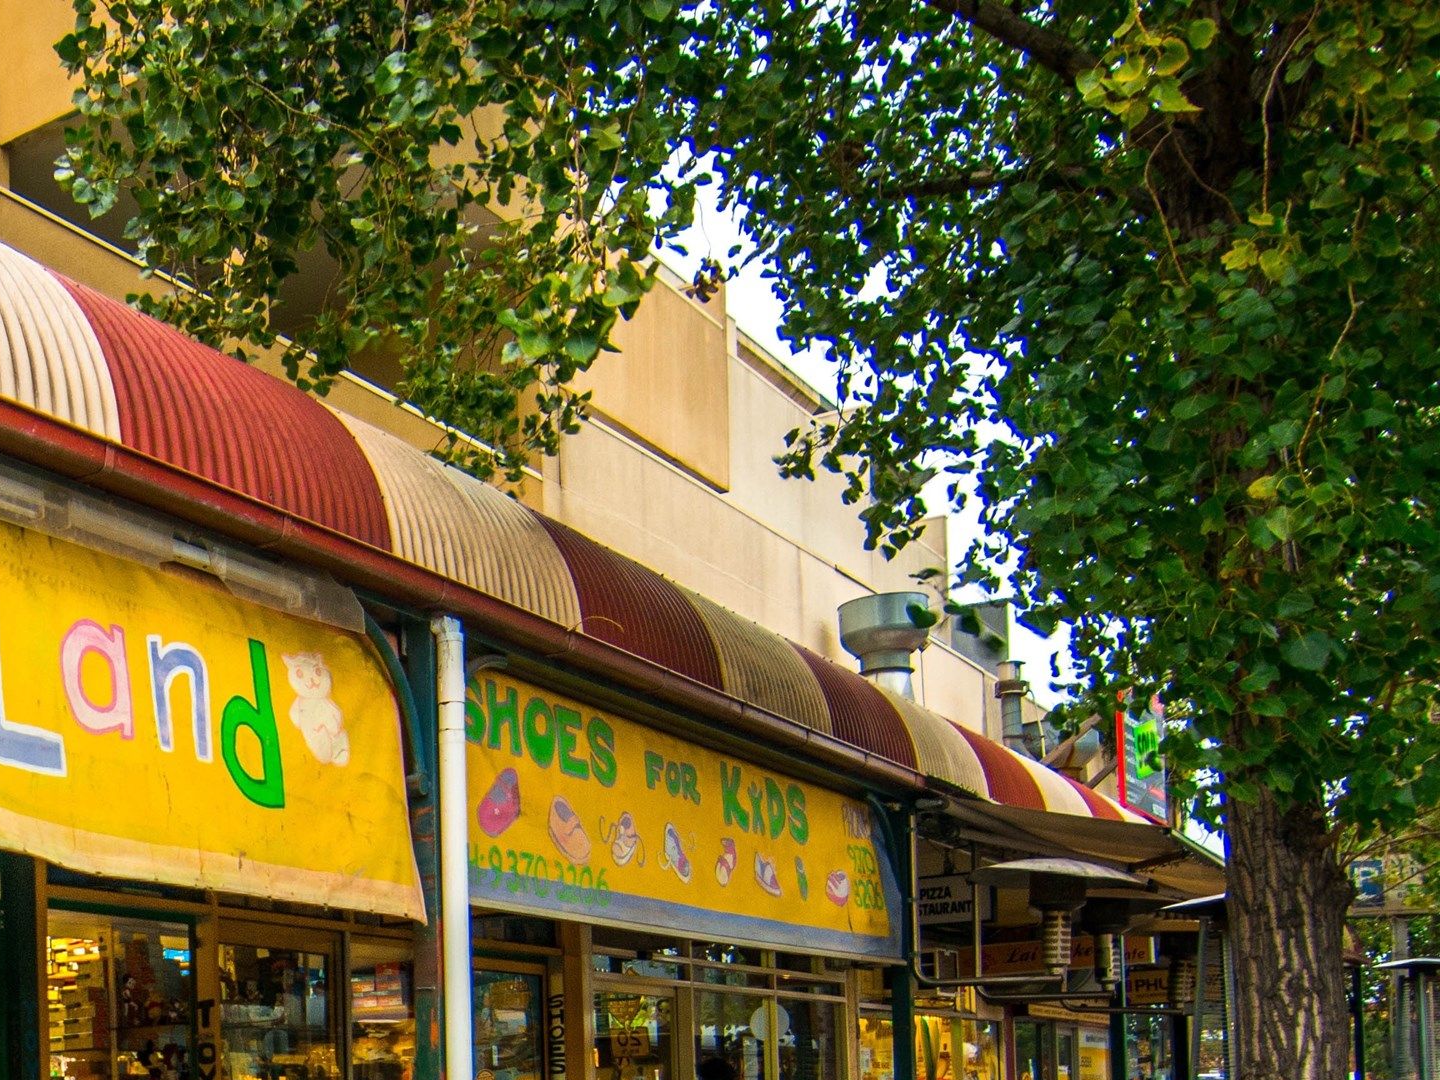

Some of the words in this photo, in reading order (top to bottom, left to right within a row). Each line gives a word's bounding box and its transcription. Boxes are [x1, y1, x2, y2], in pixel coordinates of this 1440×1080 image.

[465, 676, 617, 788] SHOES
[645, 751, 700, 805] FOR
[918, 901, 973, 916] STAURANT
[920, 887, 952, 900] PIZZA
[549, 993, 566, 1075] SHOES
